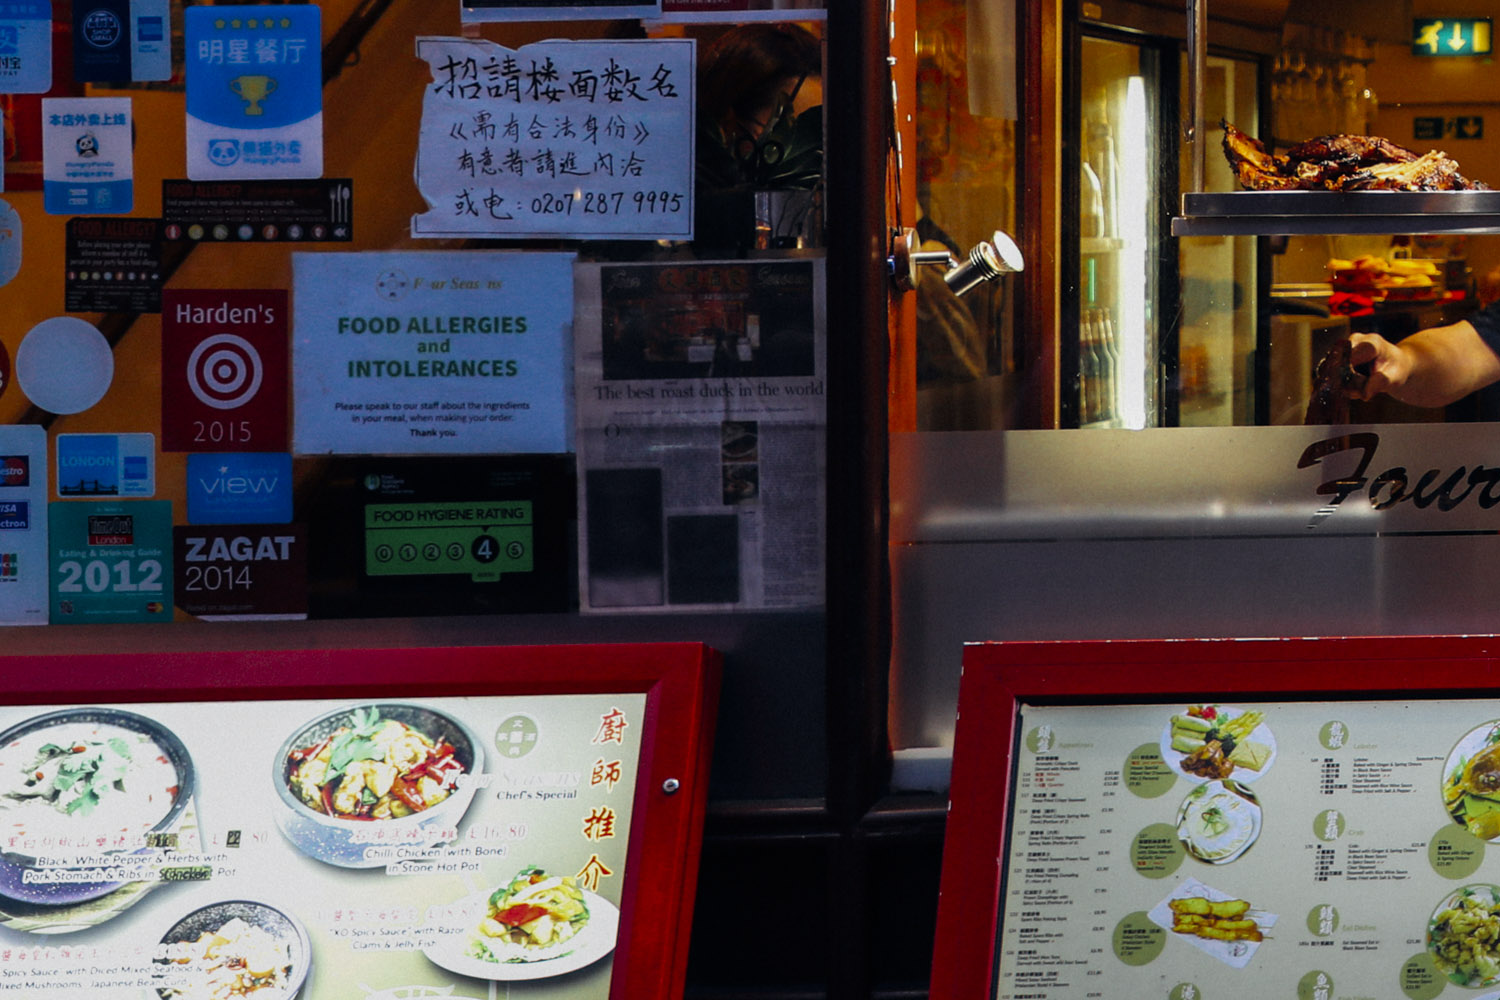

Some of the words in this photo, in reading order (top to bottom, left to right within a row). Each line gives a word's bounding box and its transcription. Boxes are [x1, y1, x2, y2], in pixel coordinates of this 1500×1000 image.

[198, 38, 307, 65] 明星餐厅
[434, 54, 679, 104] 招請楼面数名
[531, 193, 575, 216] 0207
[584, 192, 624, 215] 287
[633, 191, 684, 214] 9995
[176, 302, 275, 325] Harden's
[337, 317, 401, 335] FOOD
[407, 316, 528, 335] ALLERGIES
[417, 338, 451, 354] and
[348, 360, 518, 378] INTOLERANCES
[594, 385, 623, 401] The
[627, 384, 655, 399] best
[661, 384, 694, 399] roast
[699, 383, 734, 398] duck
[739, 383, 753, 397] in
[757, 382, 781, 397] the
[784, 381, 824, 397] world
[335, 402, 363, 411] Please
[365, 402, 390, 412] speak
[392, 403, 402, 411] to
[420, 402, 440, 411] staff
[441, 402, 465, 411] about
[467, 402, 481, 411] the
[483, 402, 530, 412] ingredients
[352, 414, 360, 423] in
[362, 415, 381, 424] your
[383, 414, 408, 424] meal,
[410, 414, 433, 423] when
[435, 414, 467, 424] making
[468, 414, 488, 424] your
[194, 421, 252, 443] 2015
[410, 428, 437, 437] Thank
[62, 457, 115, 468] LONDON
[199, 467, 278, 494] view
[374, 510, 414, 522] FOOD
[418, 509, 473, 522] HYGIENE
[476, 507, 524, 521] RATING
[95, 536, 127, 545] London
[89, 549, 97, 557] &
[185, 536, 295, 562] ZAGAT
[58, 559, 163, 592] 2012
[185, 566, 253, 591] 2014
[497, 791, 532, 800] Chef's
[535, 790, 577, 801] Special
[577, 707, 628, 891] 廚師推介
[38, 856, 68, 867] Black
[75, 855, 110, 867] White
[113, 855, 153, 868] Pepper
[167, 853, 200, 865] Herbs
[203, 853, 228, 864] with
[366, 848, 394, 860] Chilli
[397, 847, 441, 859] Chicken
[25, 870, 50, 882] Pork
[54, 869, 103, 882] Stomach
[118, 869, 141, 880] Ribs
[217, 868, 237, 878] Pot
[402, 863, 434, 874] Stone
[437, 862, 457, 872] Hot
[461, 862, 480, 872] Pot
[90, 966, 118, 976] Diced
[25, 980, 83, 990] Mushrooms
[90, 979, 134, 990] Japanese
